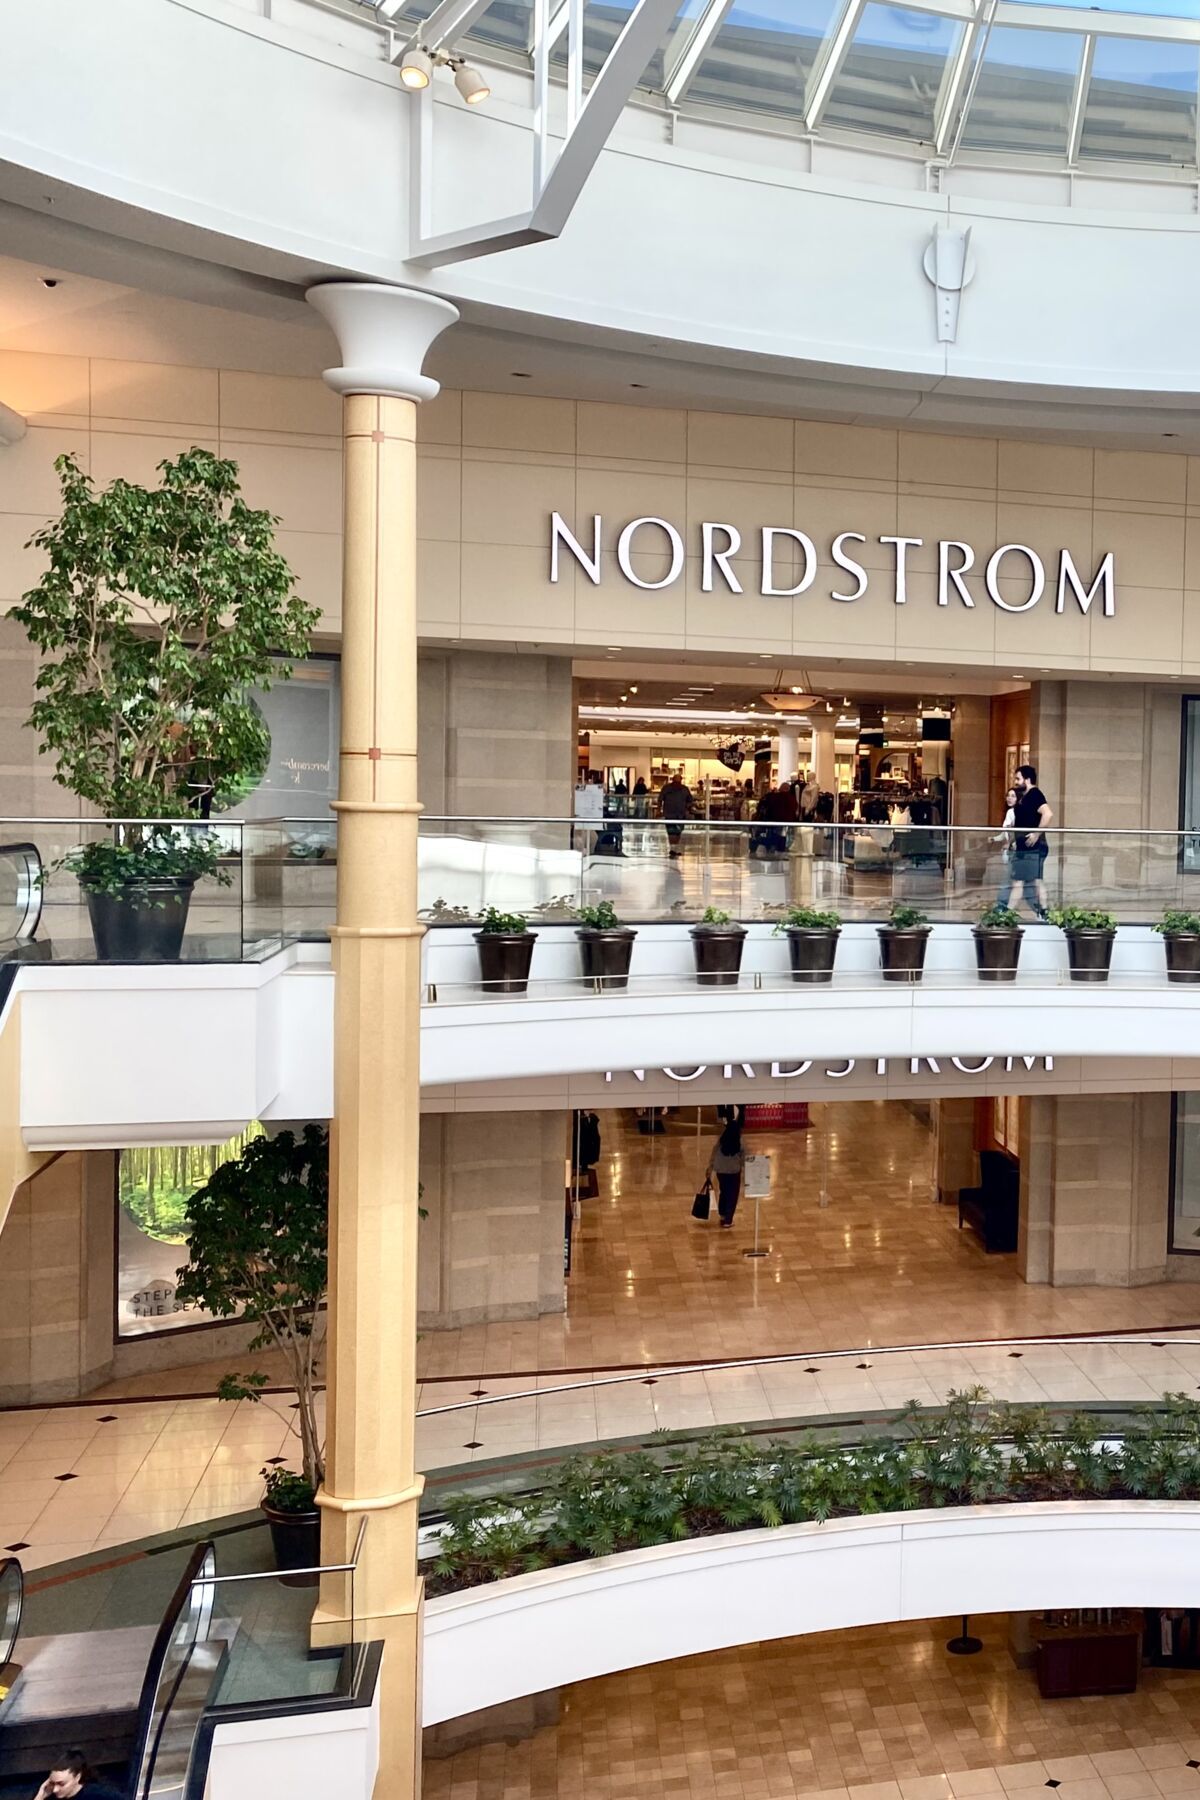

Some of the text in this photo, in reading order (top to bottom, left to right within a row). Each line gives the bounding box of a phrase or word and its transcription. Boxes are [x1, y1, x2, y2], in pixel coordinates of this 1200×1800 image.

[549, 511, 1116, 617] NORDSTROM
[133, 1289, 172, 1304] STEP
[133, 1305, 164, 1318] THE
